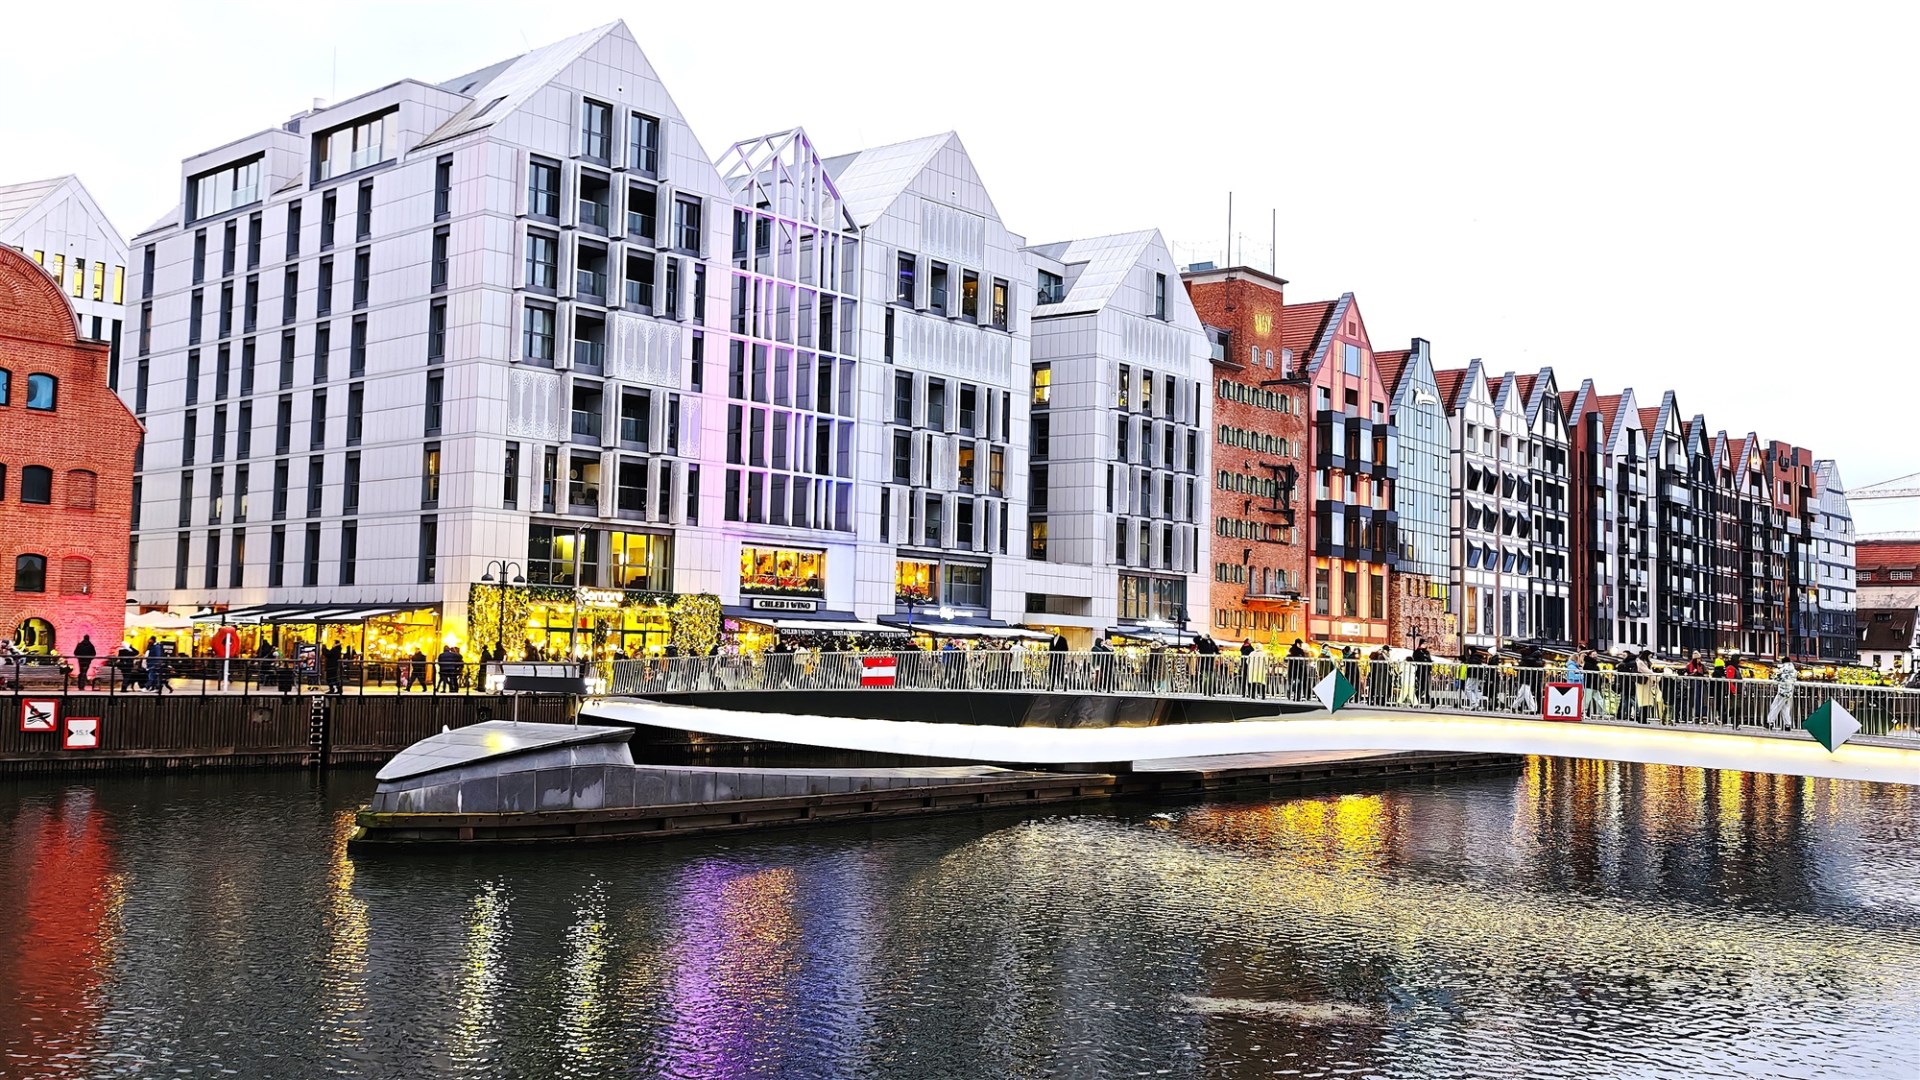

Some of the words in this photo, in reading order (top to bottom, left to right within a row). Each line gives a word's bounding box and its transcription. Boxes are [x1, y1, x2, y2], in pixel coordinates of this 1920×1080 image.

[759, 600, 785, 608] CHLEB
[790, 601, 811, 610] WINO
[1554, 705, 1571, 716] 2,0
